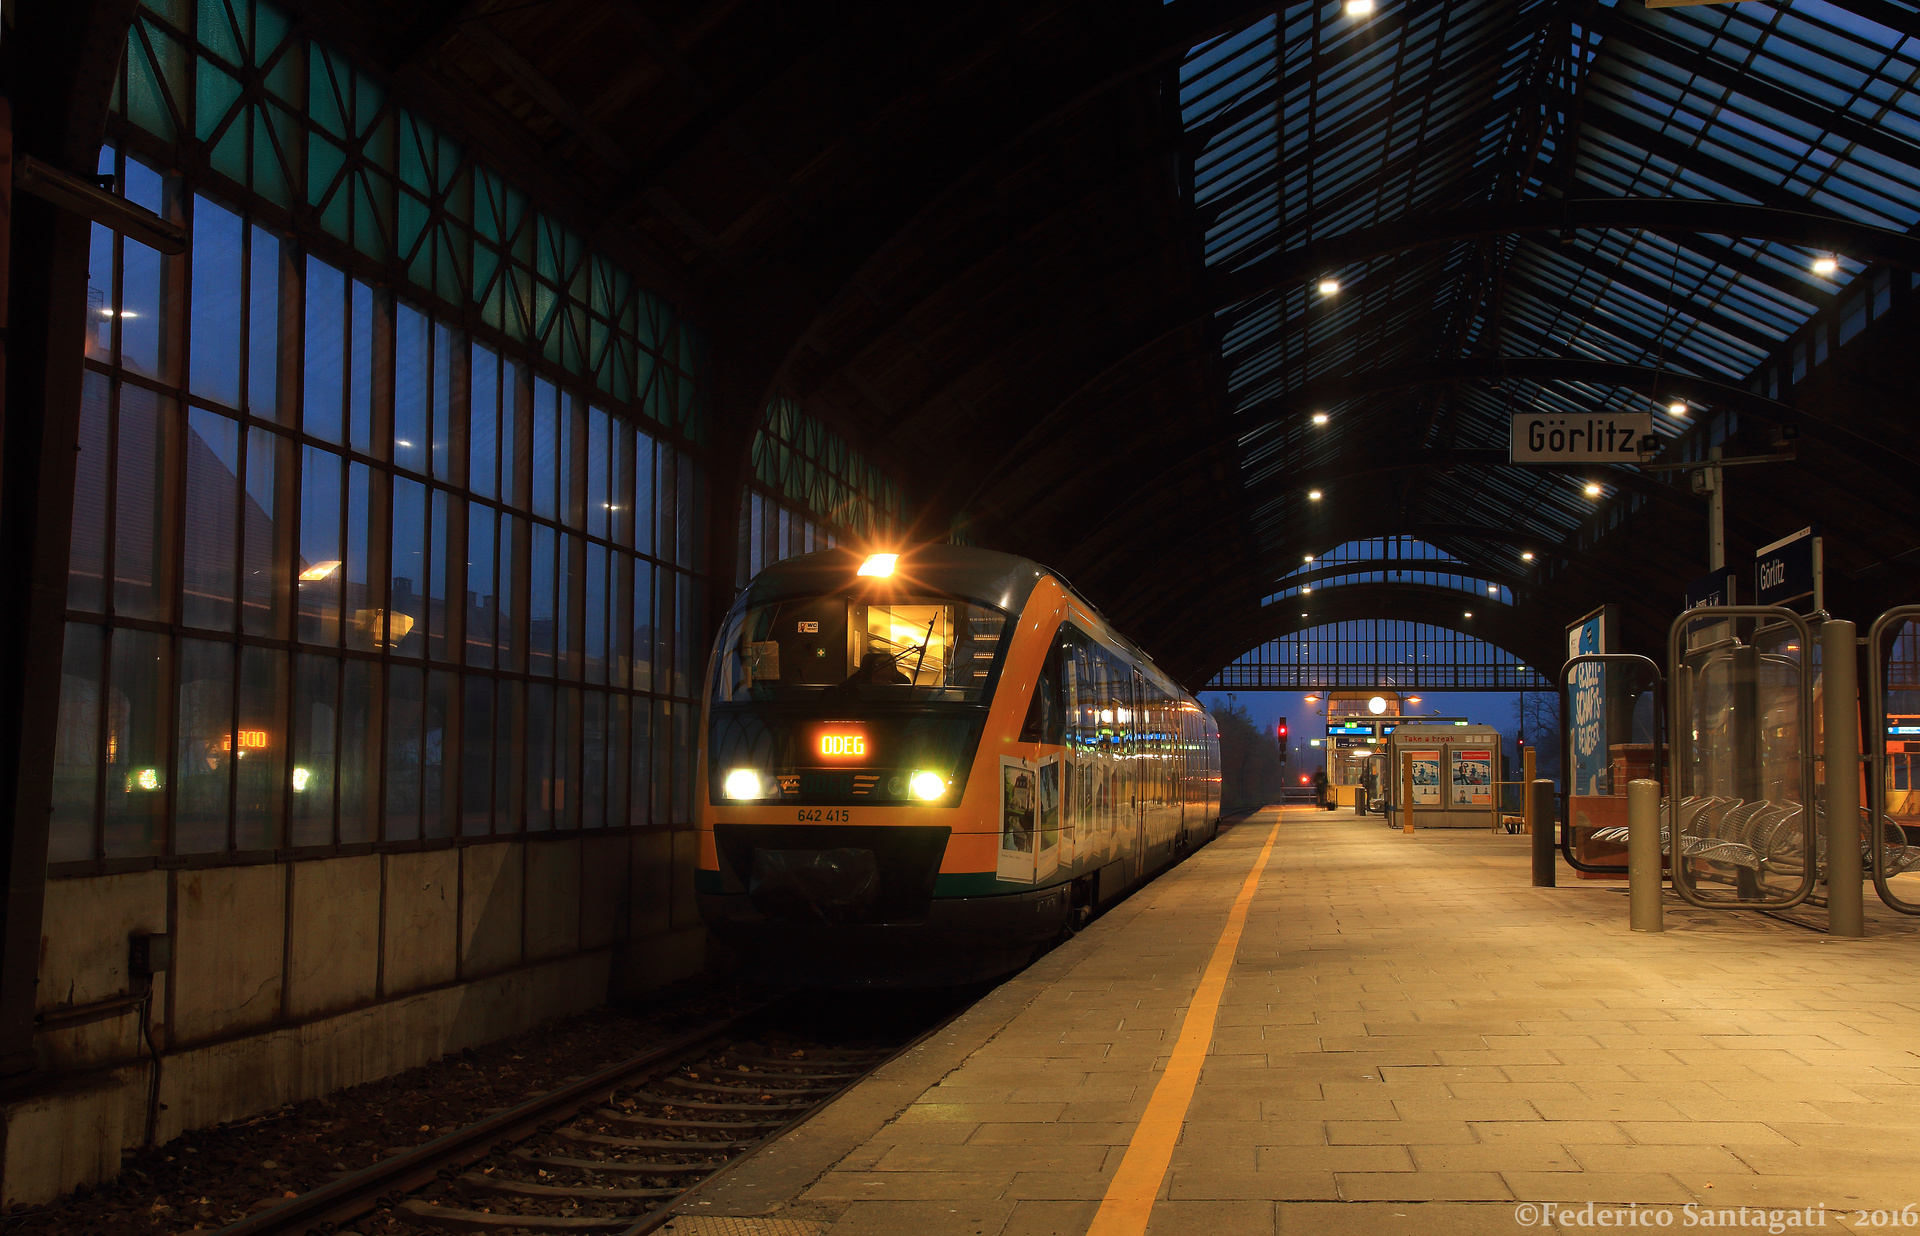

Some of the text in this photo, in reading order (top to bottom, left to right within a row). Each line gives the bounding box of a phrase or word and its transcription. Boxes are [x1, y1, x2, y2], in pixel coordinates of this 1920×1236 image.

[1528, 420, 1635, 452] Görlitz
[1760, 559, 1785, 590] Görlitz
[821, 736, 865, 755] ODEG
[798, 810, 849, 822] 642 415
